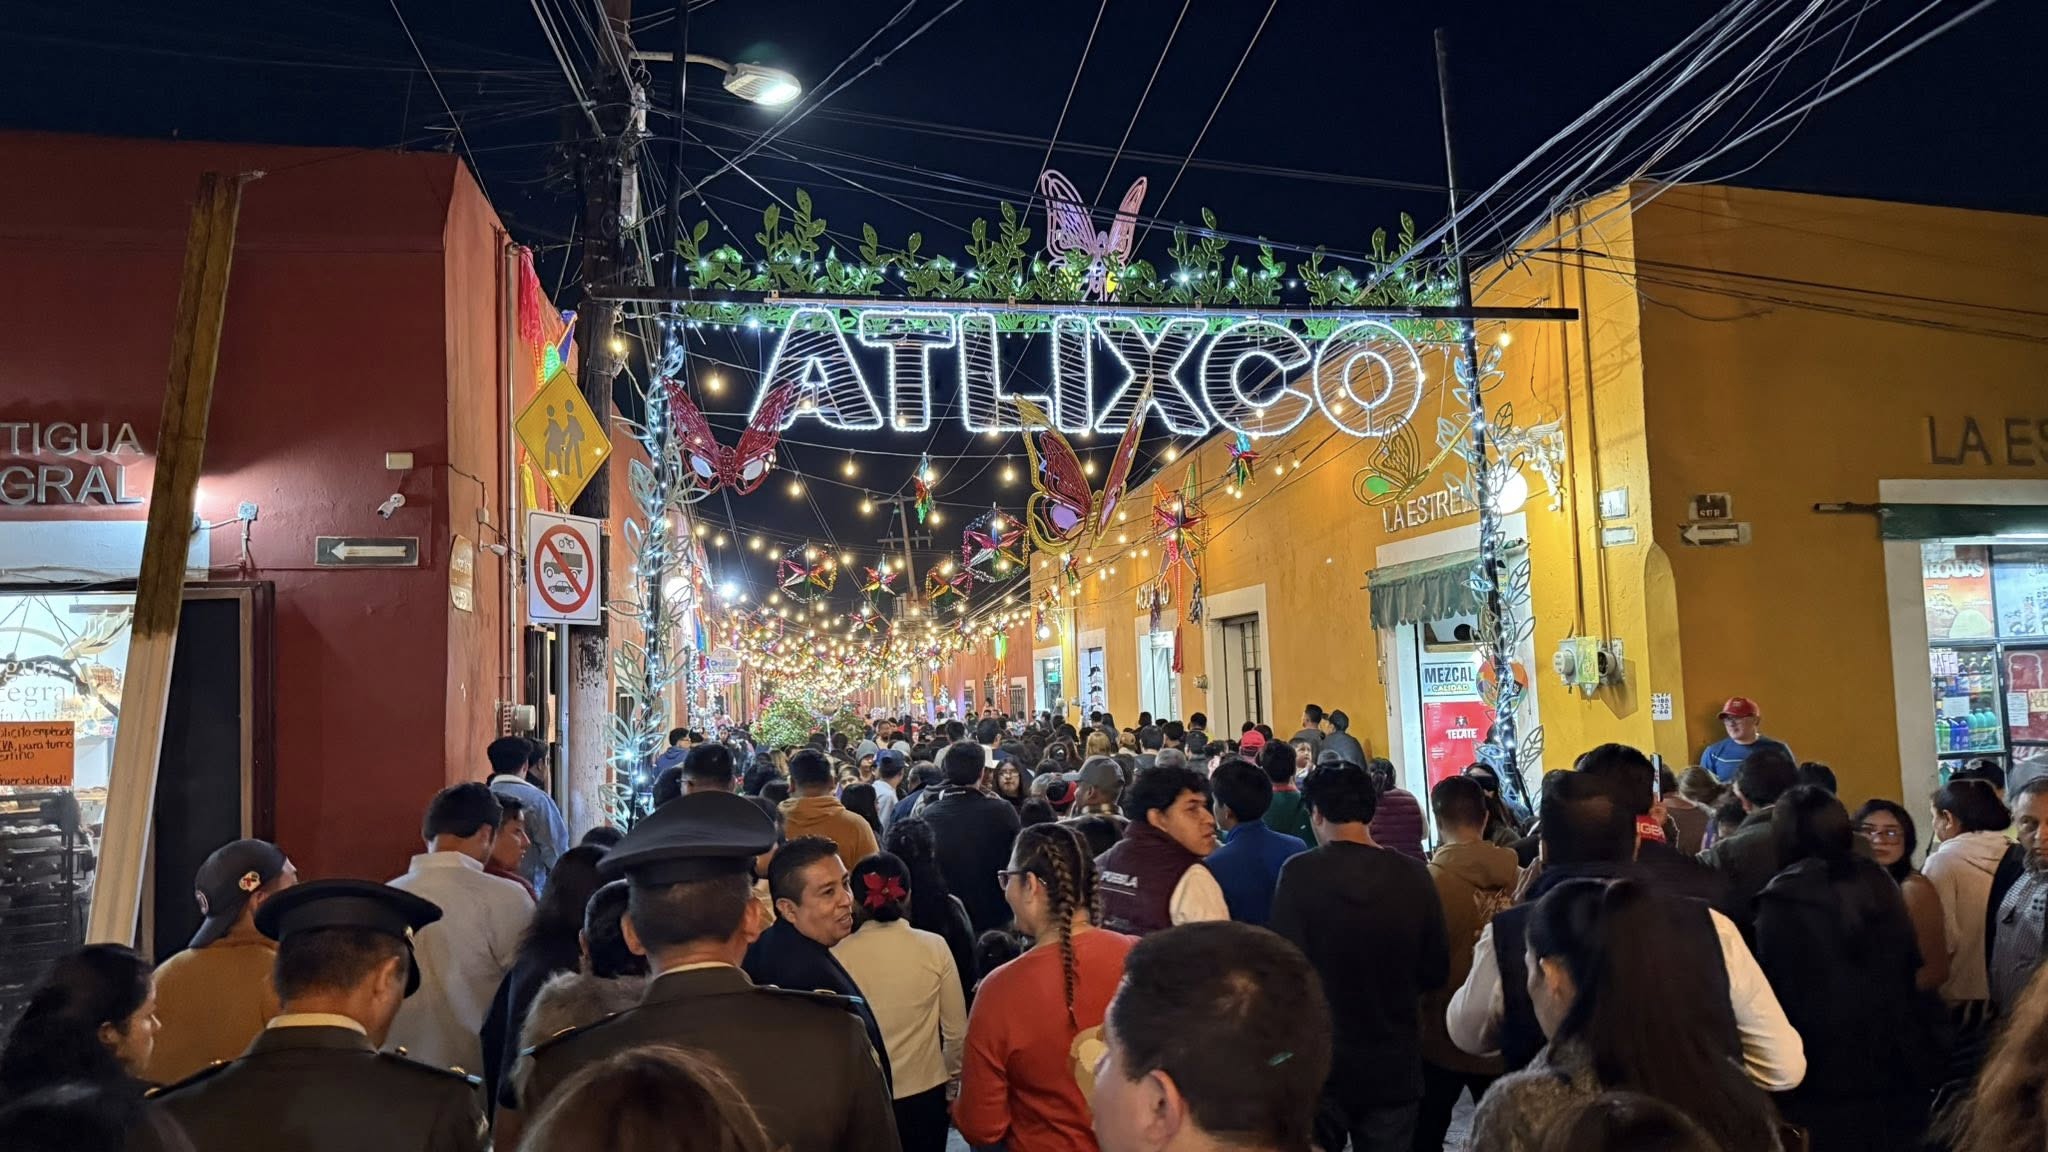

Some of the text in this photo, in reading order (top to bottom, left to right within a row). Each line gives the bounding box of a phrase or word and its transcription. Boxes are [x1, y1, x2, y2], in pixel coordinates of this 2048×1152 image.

[750, 307, 1423, 437] ATLIXCO
[0, 422, 144, 456] TIGUA
[1926, 415, 1993, 466] LA
[0, 465, 145, 505] GRAL
[1383, 502, 1406, 533] LA
[1424, 666, 1475, 683] MEZCAL
[1432, 684, 1469, 693] CALIDAD
[1446, 728, 1479, 740] TECATE
